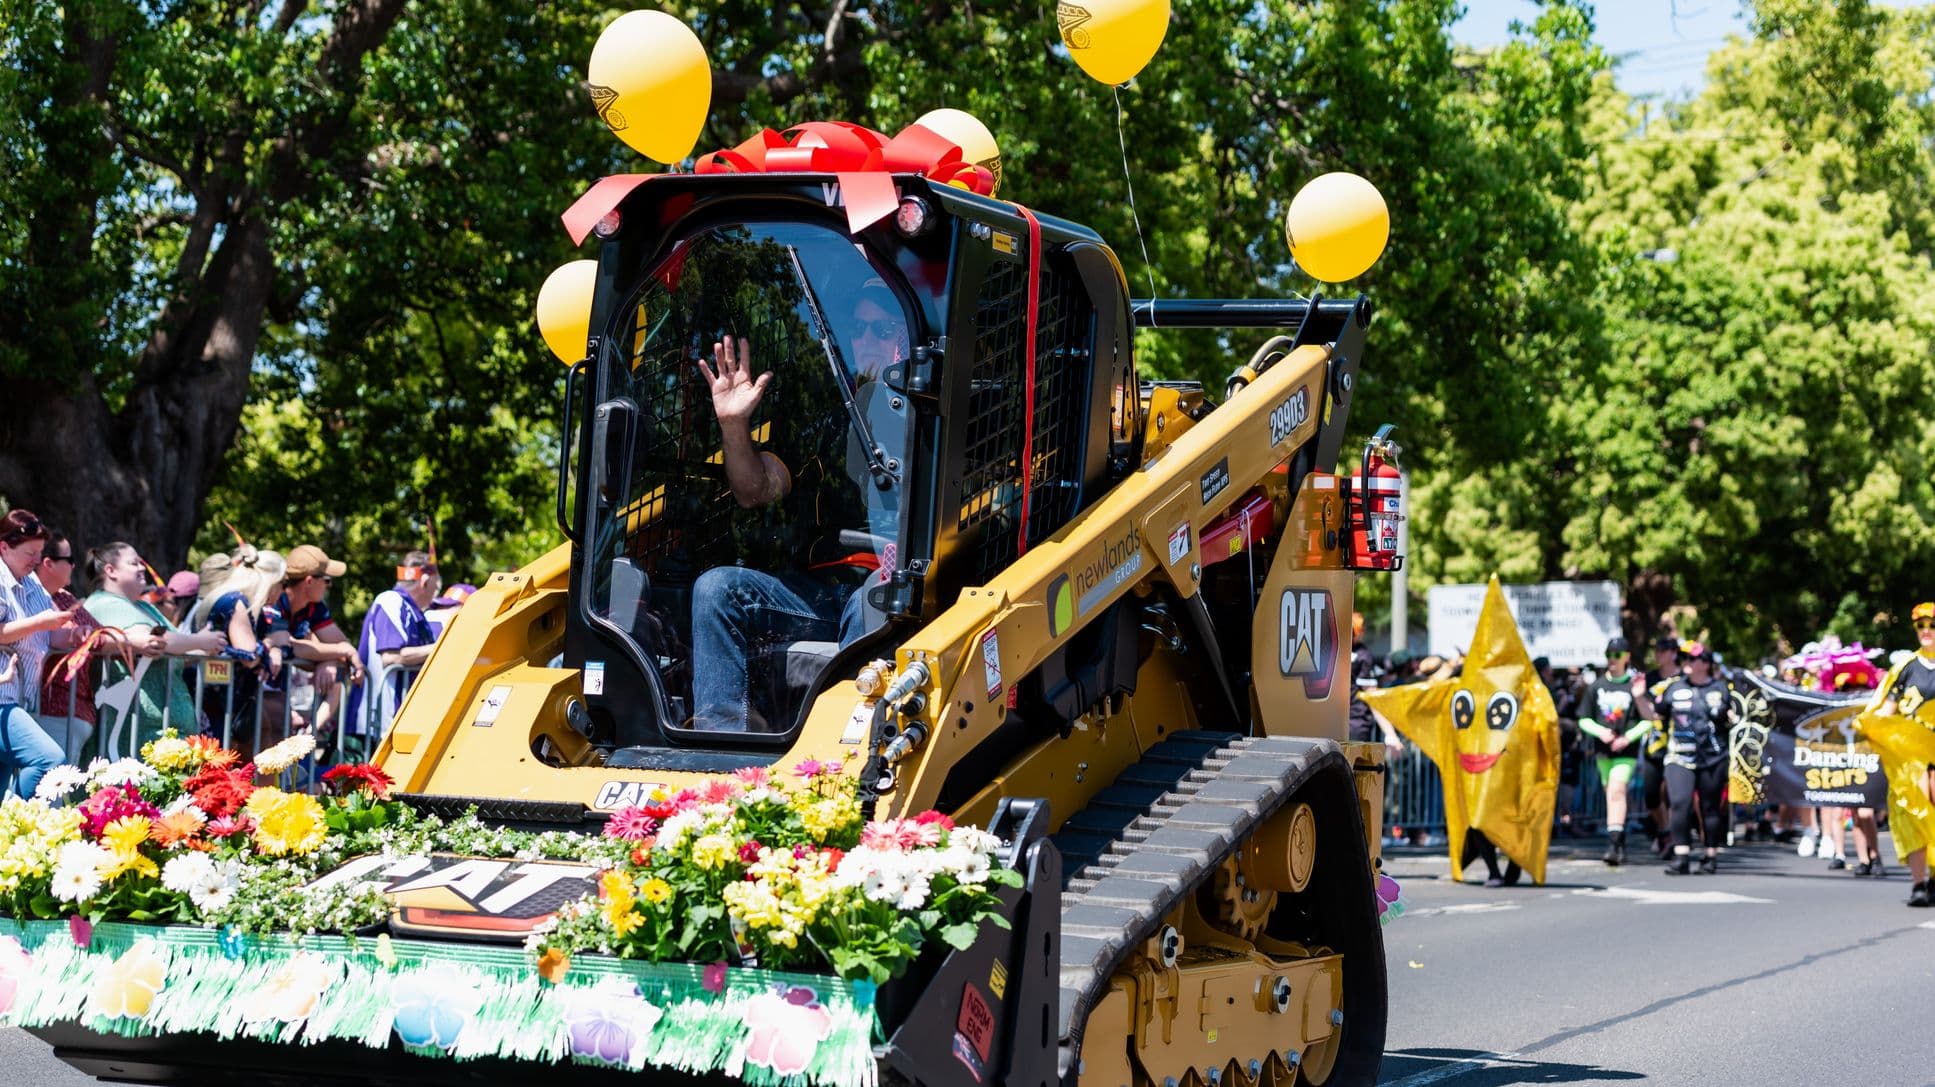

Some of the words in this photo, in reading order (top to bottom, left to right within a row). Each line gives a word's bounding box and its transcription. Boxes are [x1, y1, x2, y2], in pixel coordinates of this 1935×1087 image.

[1270, 389, 1305, 448] 299D3
[1076, 520, 1141, 597] newlands
[1114, 553, 1142, 585] GROUP
[1281, 590, 1326, 674] CAT
[1793, 746, 1880, 774] Dancing
[1805, 767, 1868, 790] Stars
[594, 781, 660, 810] CAT
[301, 854, 600, 914] CAT
